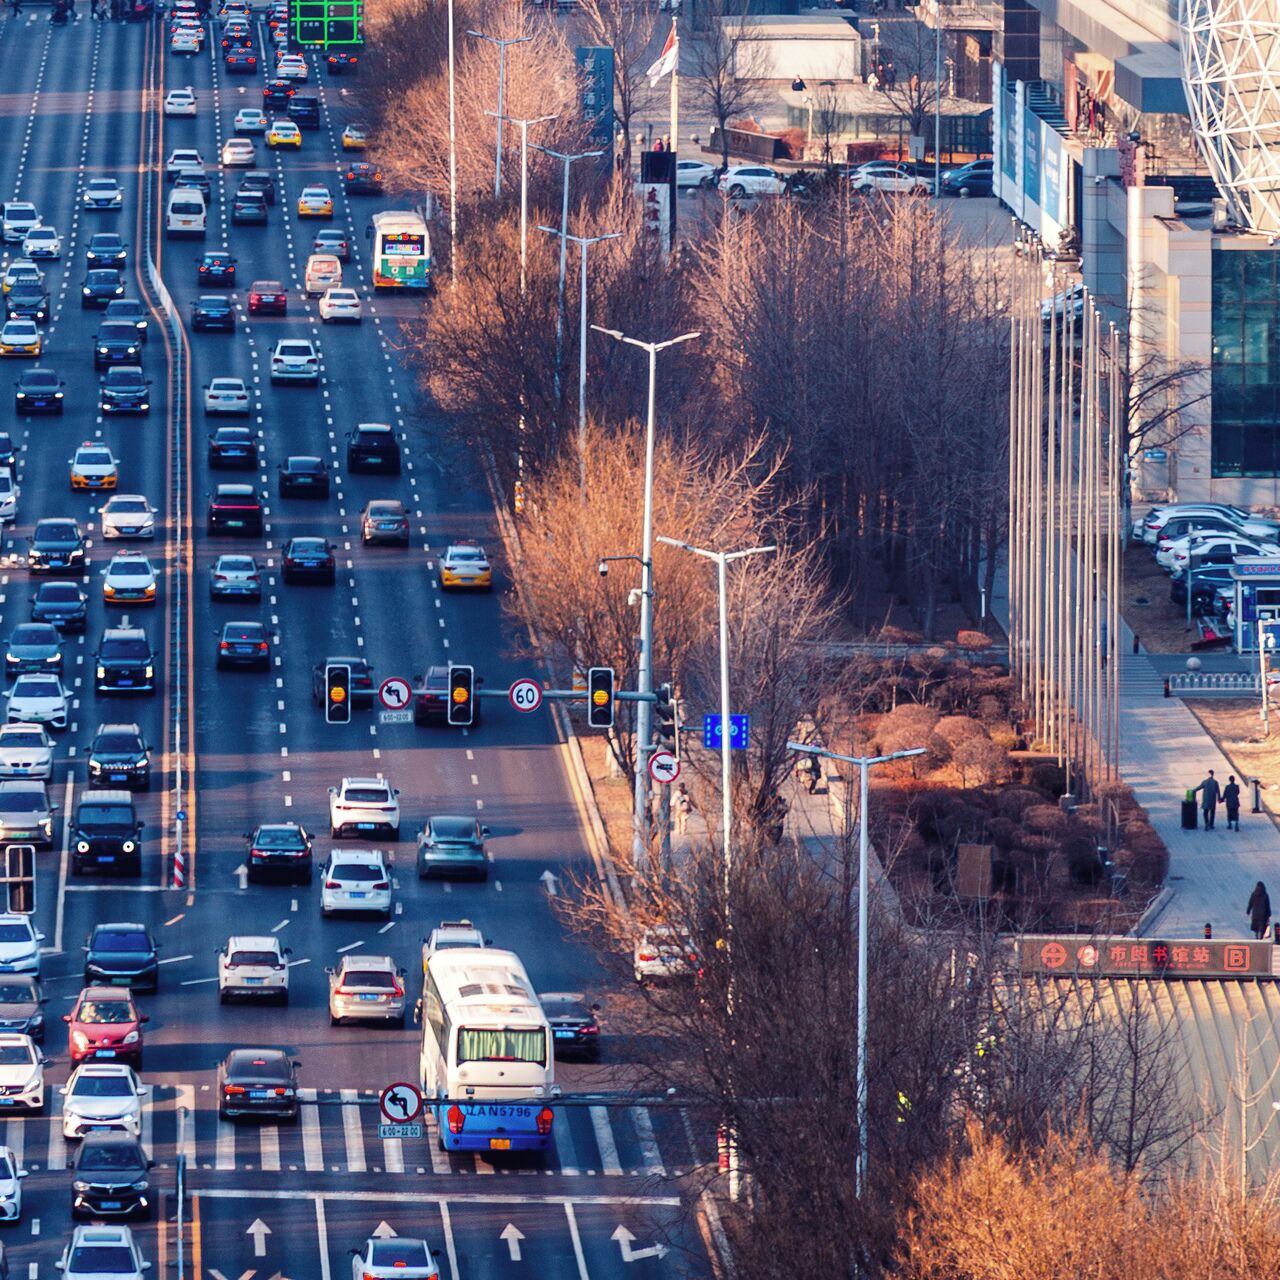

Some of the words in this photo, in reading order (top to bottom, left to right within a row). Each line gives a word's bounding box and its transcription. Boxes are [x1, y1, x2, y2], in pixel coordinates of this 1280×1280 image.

[515, 687, 535, 705] 60
[1110, 945, 1210, 963] 市图书馆站
